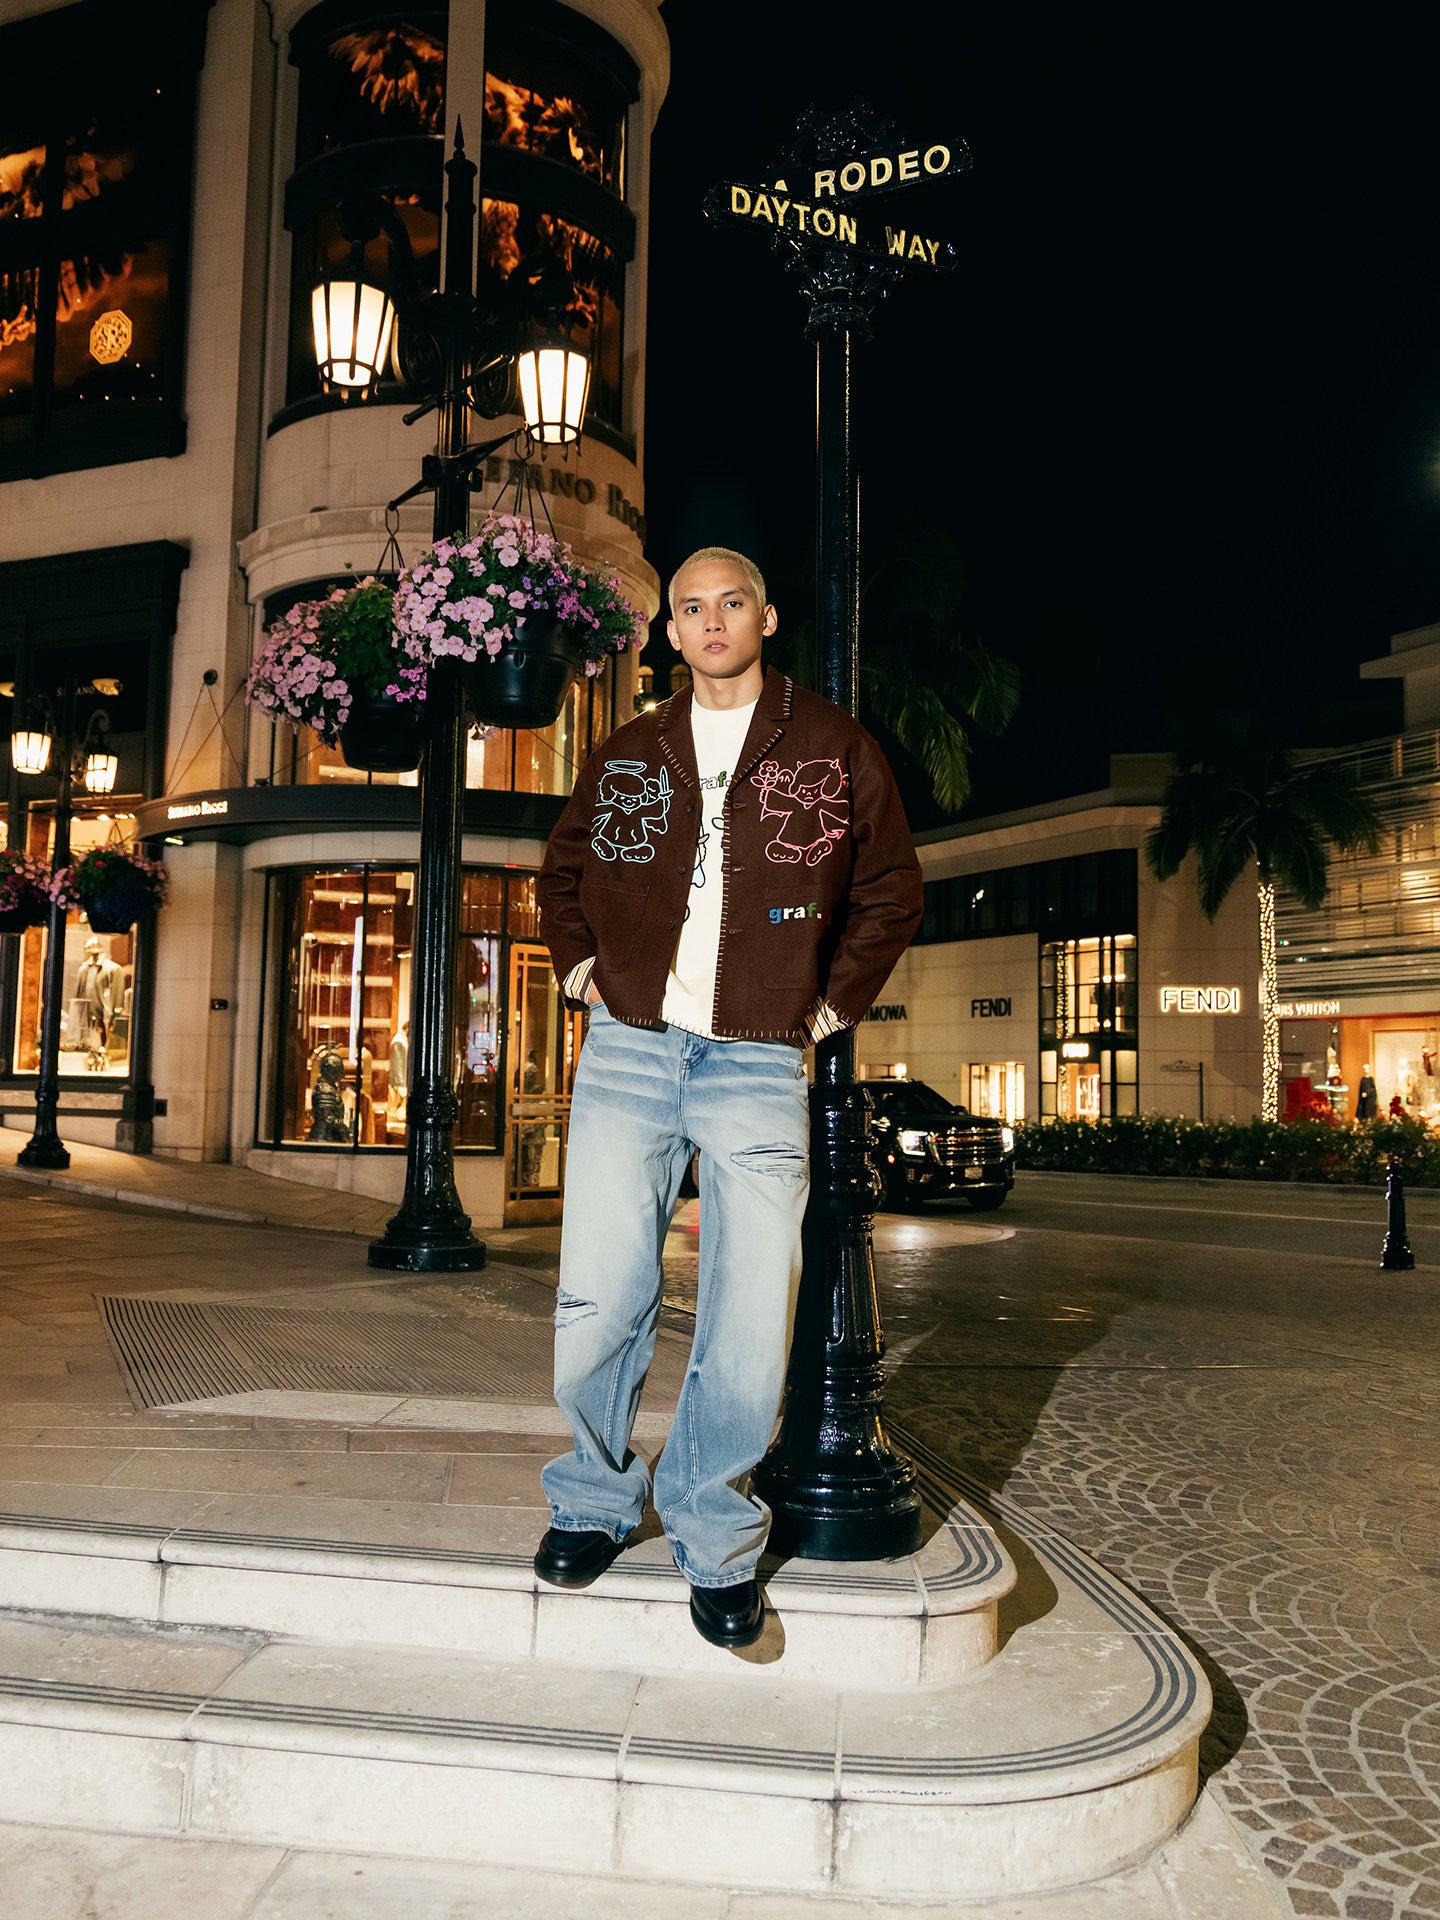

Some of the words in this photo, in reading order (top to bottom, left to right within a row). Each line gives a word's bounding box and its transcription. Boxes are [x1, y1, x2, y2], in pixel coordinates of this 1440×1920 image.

[814, 145, 951, 198] RODEO
[731, 185, 858, 245] DAYTON
[885, 226, 940, 265] WAY
[769, 901, 822, 925] graf.
[971, 997, 1012, 1019] FENDI
[1160, 986, 1240, 1013] FENDI
[862, 1004, 907, 1022] IMOWA
